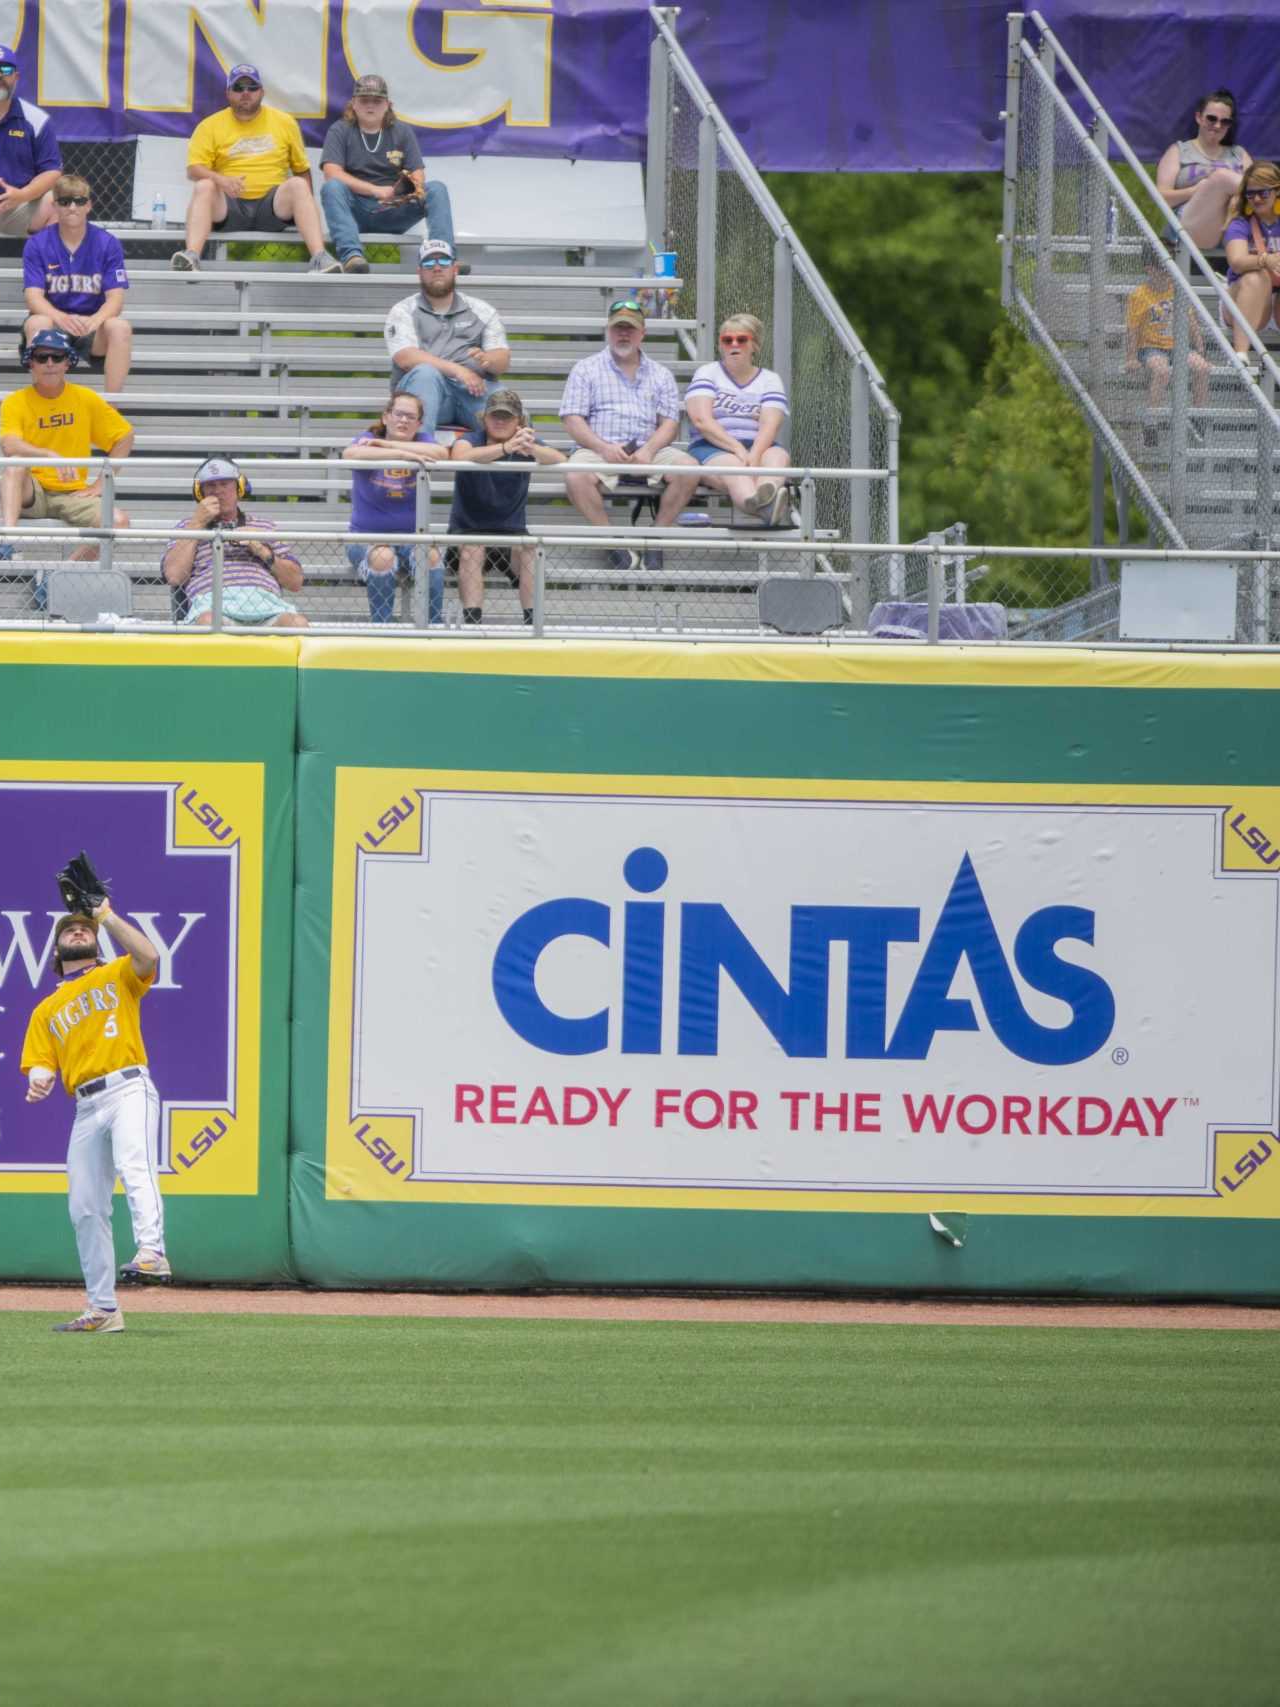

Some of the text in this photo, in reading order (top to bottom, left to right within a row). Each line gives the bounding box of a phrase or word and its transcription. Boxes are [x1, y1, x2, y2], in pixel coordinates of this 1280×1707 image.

[46, 272, 103, 295] TIGERS
[38, 412, 75, 429] LSU
[181, 789, 233, 841] LSU
[363, 795, 416, 848] LSU
[1229, 813, 1280, 865] LSU
[48, 982, 120, 1048] TIGERS
[454, 1084, 632, 1127] READY
[655, 1088, 759, 1131] FOR
[779, 1091, 882, 1132] THE
[902, 1093, 1179, 1137] WORKDAY
[176, 1116, 228, 1169] LSU
[353, 1122, 406, 1176] LSU
[1221, 1139, 1273, 1192] LSU
